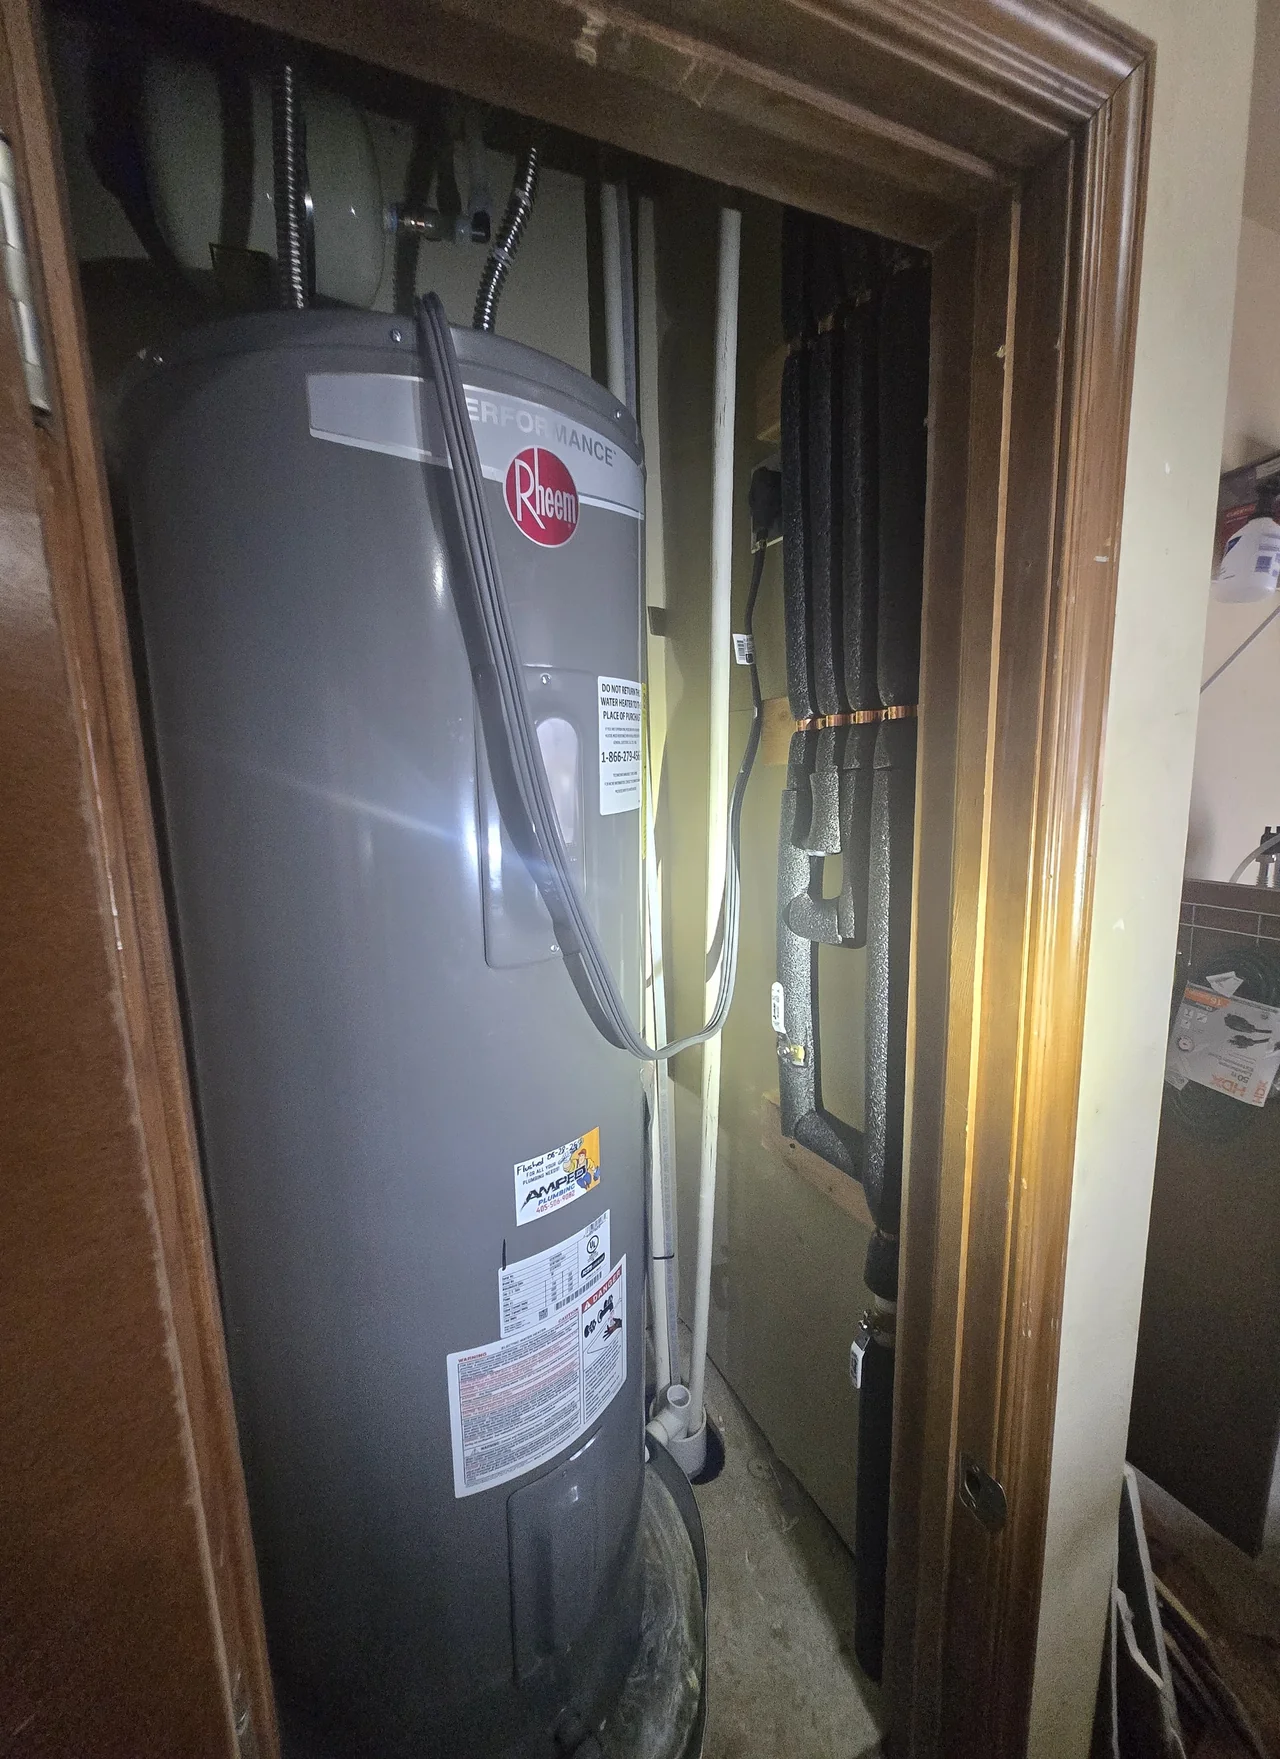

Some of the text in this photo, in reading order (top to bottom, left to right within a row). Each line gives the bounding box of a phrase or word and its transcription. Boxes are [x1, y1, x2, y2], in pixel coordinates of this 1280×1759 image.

[465, 397, 614, 468] ERFORMANCE
[514, 446, 577, 530] Rheem
[601, 683, 611, 693] DO
[611, 684, 622, 694] NOT
[600, 696, 618, 707] WATER
[618, 698, 633, 708] HEATER
[602, 710, 620, 721] PLACE
[620, 711, 626, 721] OF
[1210, 1073, 1247, 1097] HDX
[526, 1162, 556, 1178] FOR ALL YOUR
[519, 1165, 587, 1213] AMPED
[522, 1174, 545, 1186] PLUMBING
[537, 1183, 576, 1206] PLUMBING
[593, 1269, 622, 1302] DANGER
[458, 1352, 487, 1363] WARNING
